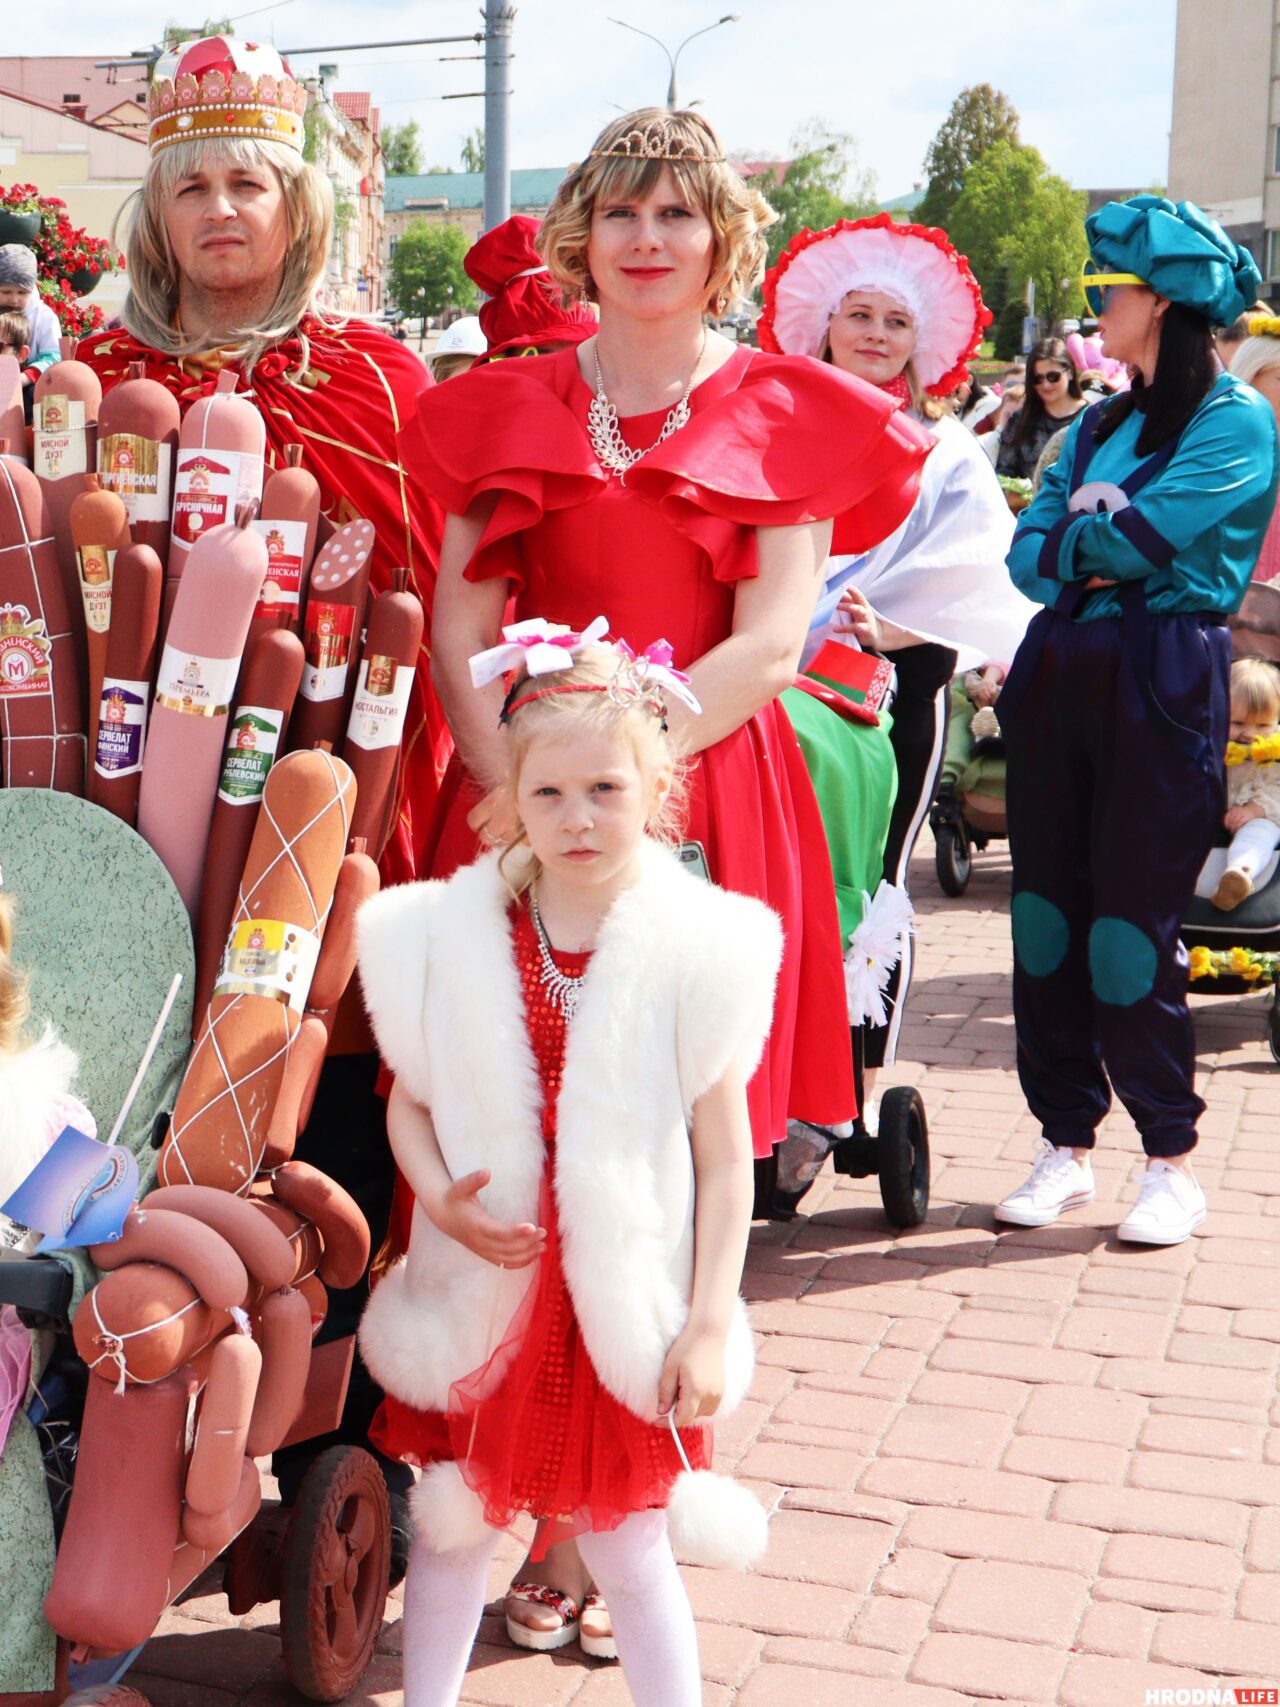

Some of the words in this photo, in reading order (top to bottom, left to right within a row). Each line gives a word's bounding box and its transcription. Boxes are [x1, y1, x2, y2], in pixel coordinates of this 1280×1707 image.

[40, 439, 69, 449] МЯСНОЙ
[45, 450, 63, 460] ДУЭТ
[266, 567, 300, 577] ЕНСКАЯ
[84, 589, 112, 599] МЯСНОЙ
[89, 602, 107, 611] ДУЭТ
[169, 682, 211, 698] ПРЕМЬЕРА
[355, 701, 399, 717] НОСТАЛЬГИЯ
[98, 729, 131, 744] СЕРВЕЛАТ
[97, 740, 129, 754] ФИНСКИЙ
[226, 756, 262, 772] СЕРВЕЛАТ
